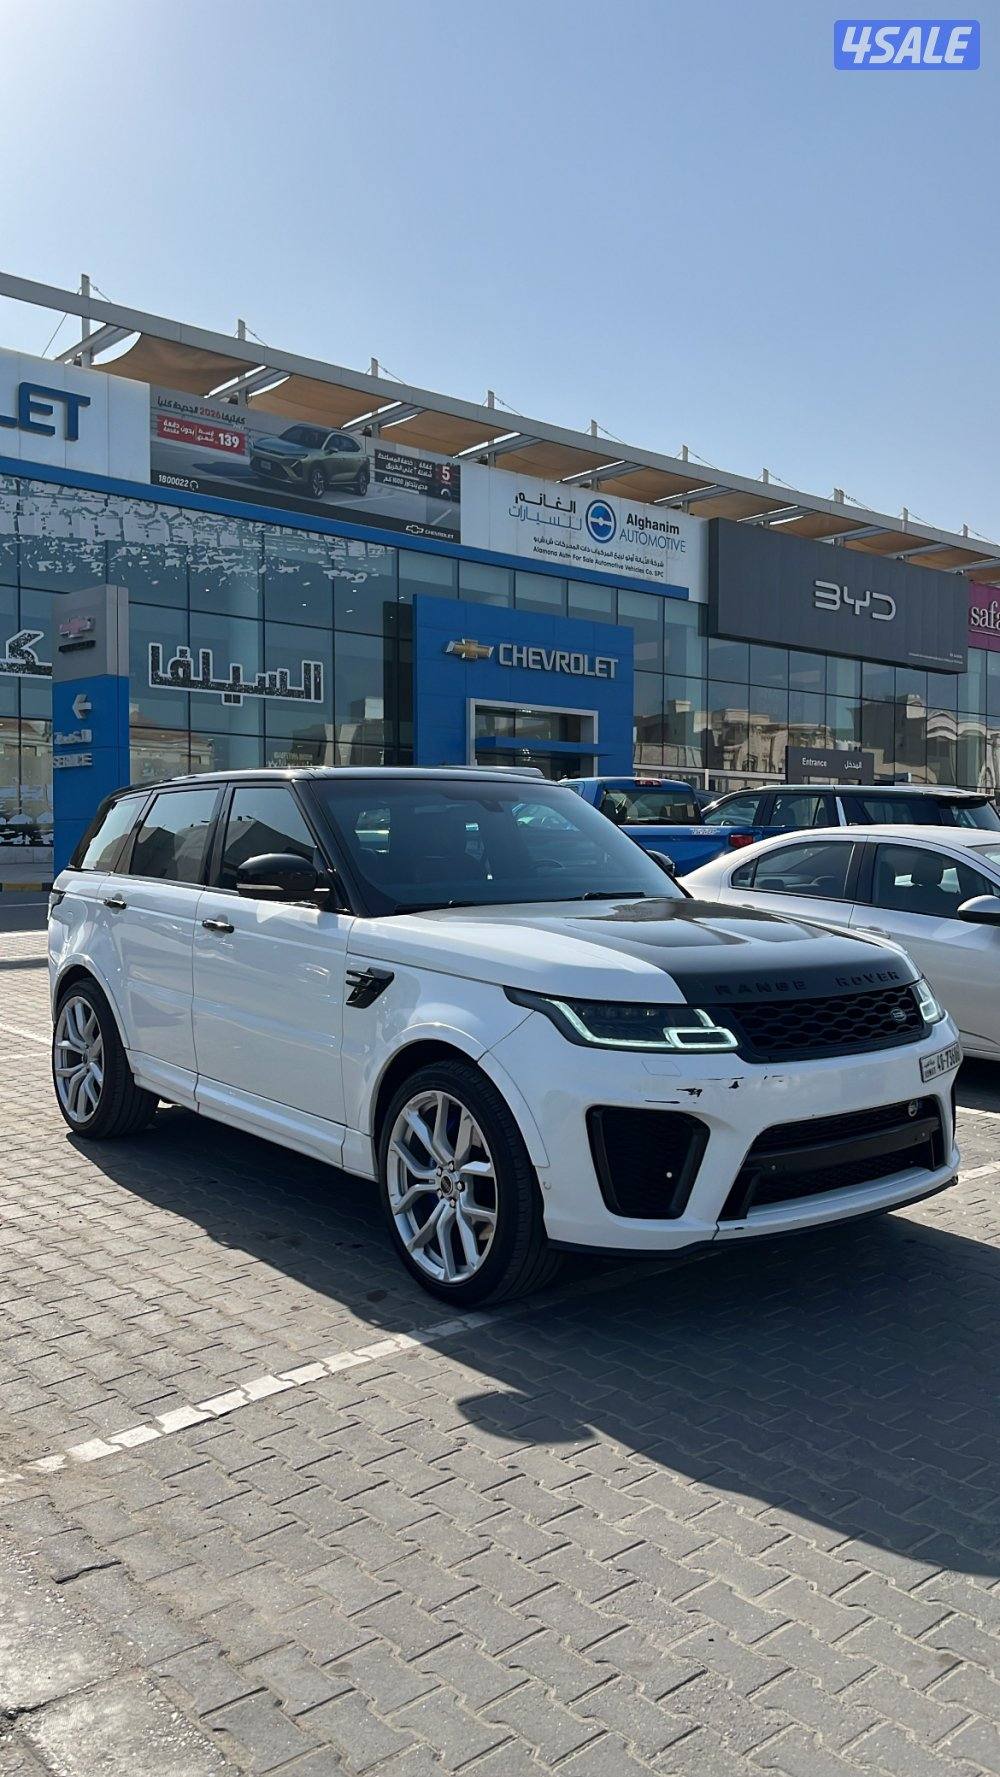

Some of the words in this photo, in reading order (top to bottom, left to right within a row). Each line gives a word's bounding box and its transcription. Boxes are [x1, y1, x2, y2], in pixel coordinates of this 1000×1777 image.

[0, 382, 91, 441] ET
[200, 406, 221, 419] 2026
[219, 433, 240, 448] 139
[158, 474, 189, 488] 1800022
[441, 465, 450, 481] 5
[508, 505, 582, 531] للسيارات
[626, 512, 680, 535] Alghanim
[620, 529, 686, 553] AUTOMOTIVE
[583, 556, 594, 564] Sale
[595, 559, 624, 570] Automotive
[625, 564, 645, 574] Vehicles
[815, 580, 896, 621] BYD
[499, 643, 619, 679] CHEVROLET
[802, 757, 828, 767] Entrance
[844, 760, 863, 770] المدخل
[714, 981, 807, 996] RANGE
[834, 970, 901, 988] ROVER
